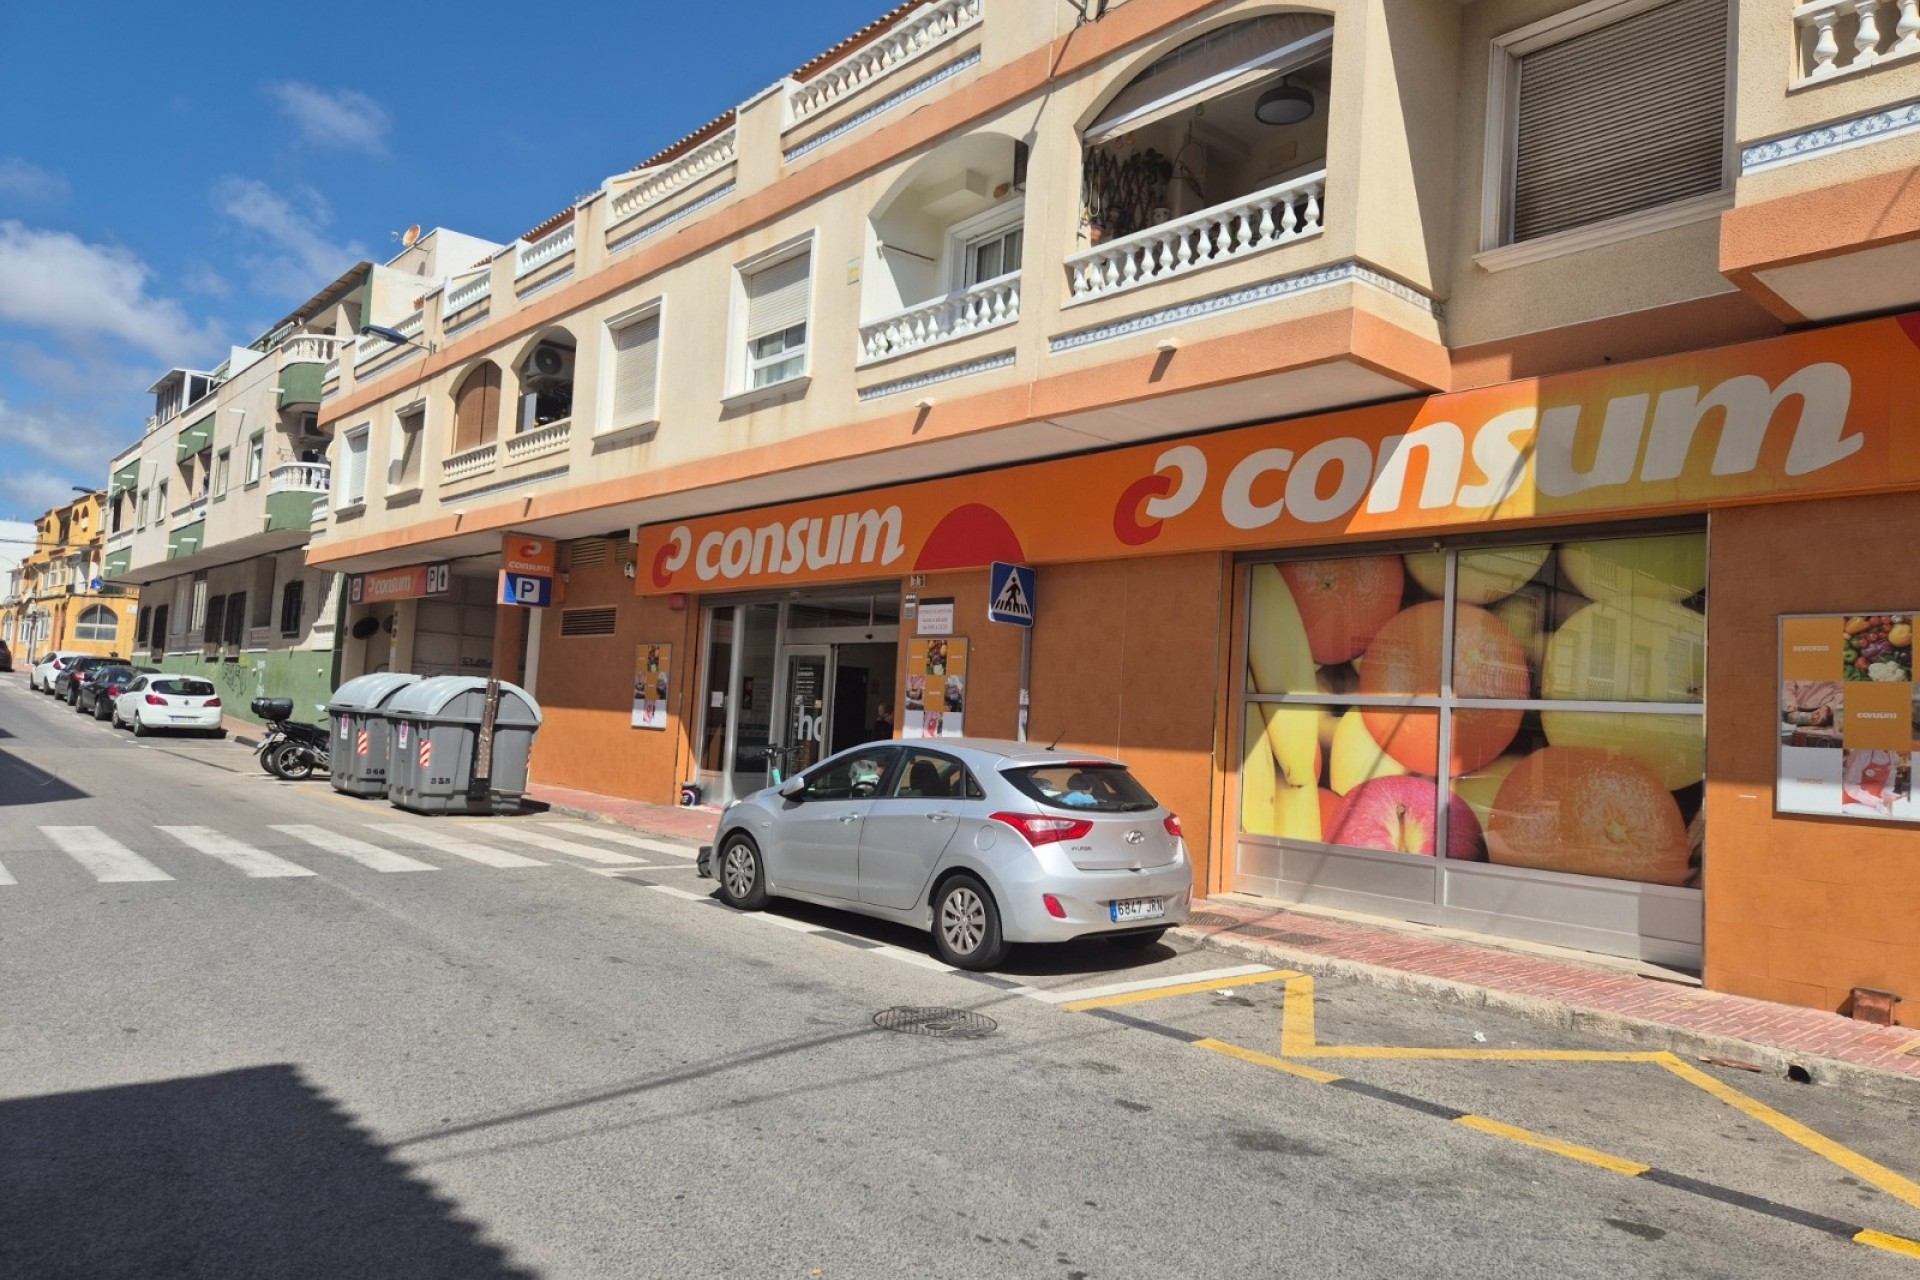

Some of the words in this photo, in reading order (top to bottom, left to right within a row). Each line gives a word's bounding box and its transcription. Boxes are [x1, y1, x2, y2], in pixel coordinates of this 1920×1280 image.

[1221, 362, 1864, 529] consum
[695, 505, 905, 581] consum
[509, 561, 550, 572] consum
[375, 575, 412, 594] consum
[521, 581, 534, 598] P
[1118, 900, 1141, 916] 6847
